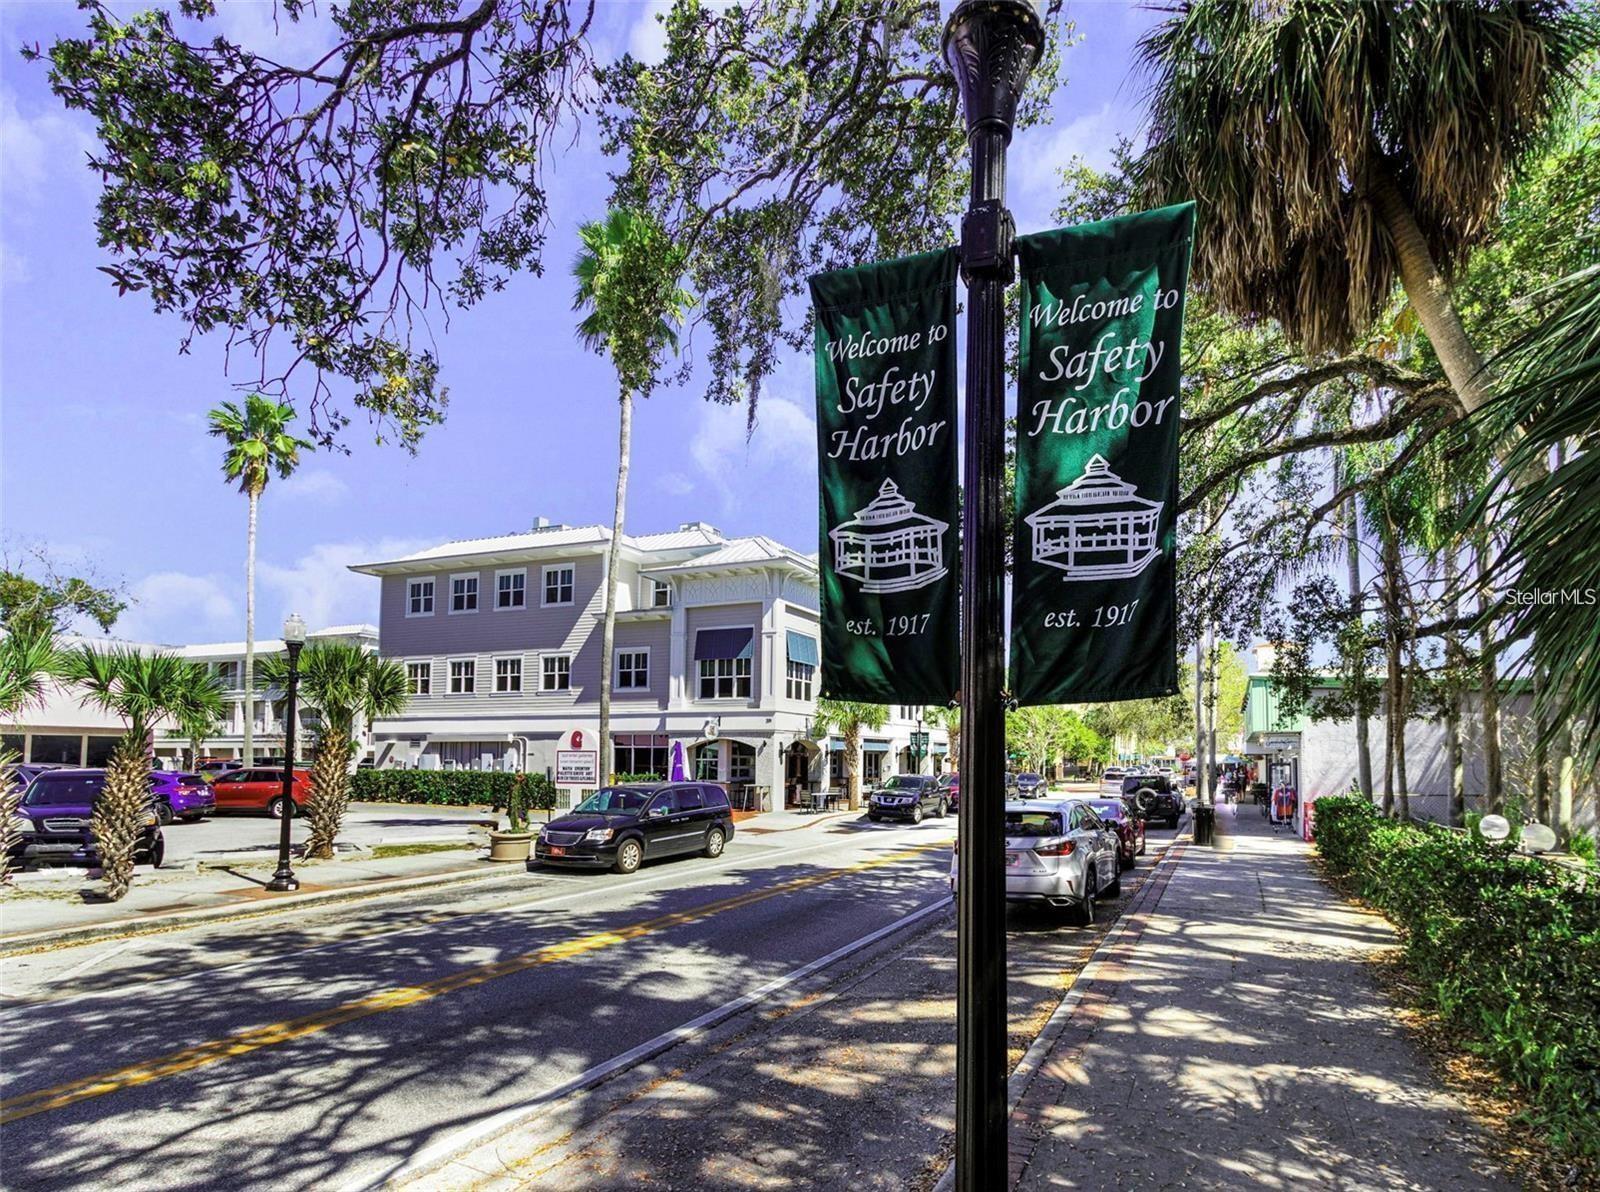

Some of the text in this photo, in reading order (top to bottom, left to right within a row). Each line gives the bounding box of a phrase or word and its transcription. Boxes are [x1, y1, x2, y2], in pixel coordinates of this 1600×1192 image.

[1029, 288, 1179, 328] Welcome to
[825, 324, 947, 363] Welcome to
[1039, 332, 1165, 391] Safety
[837, 366, 935, 419] Safety
[1028, 388, 1174, 436] Harbor
[828, 418, 946, 461] Harbor
[846, 613, 930, 637] est. 1917
[1044, 599, 1139, 629] est. 1917
